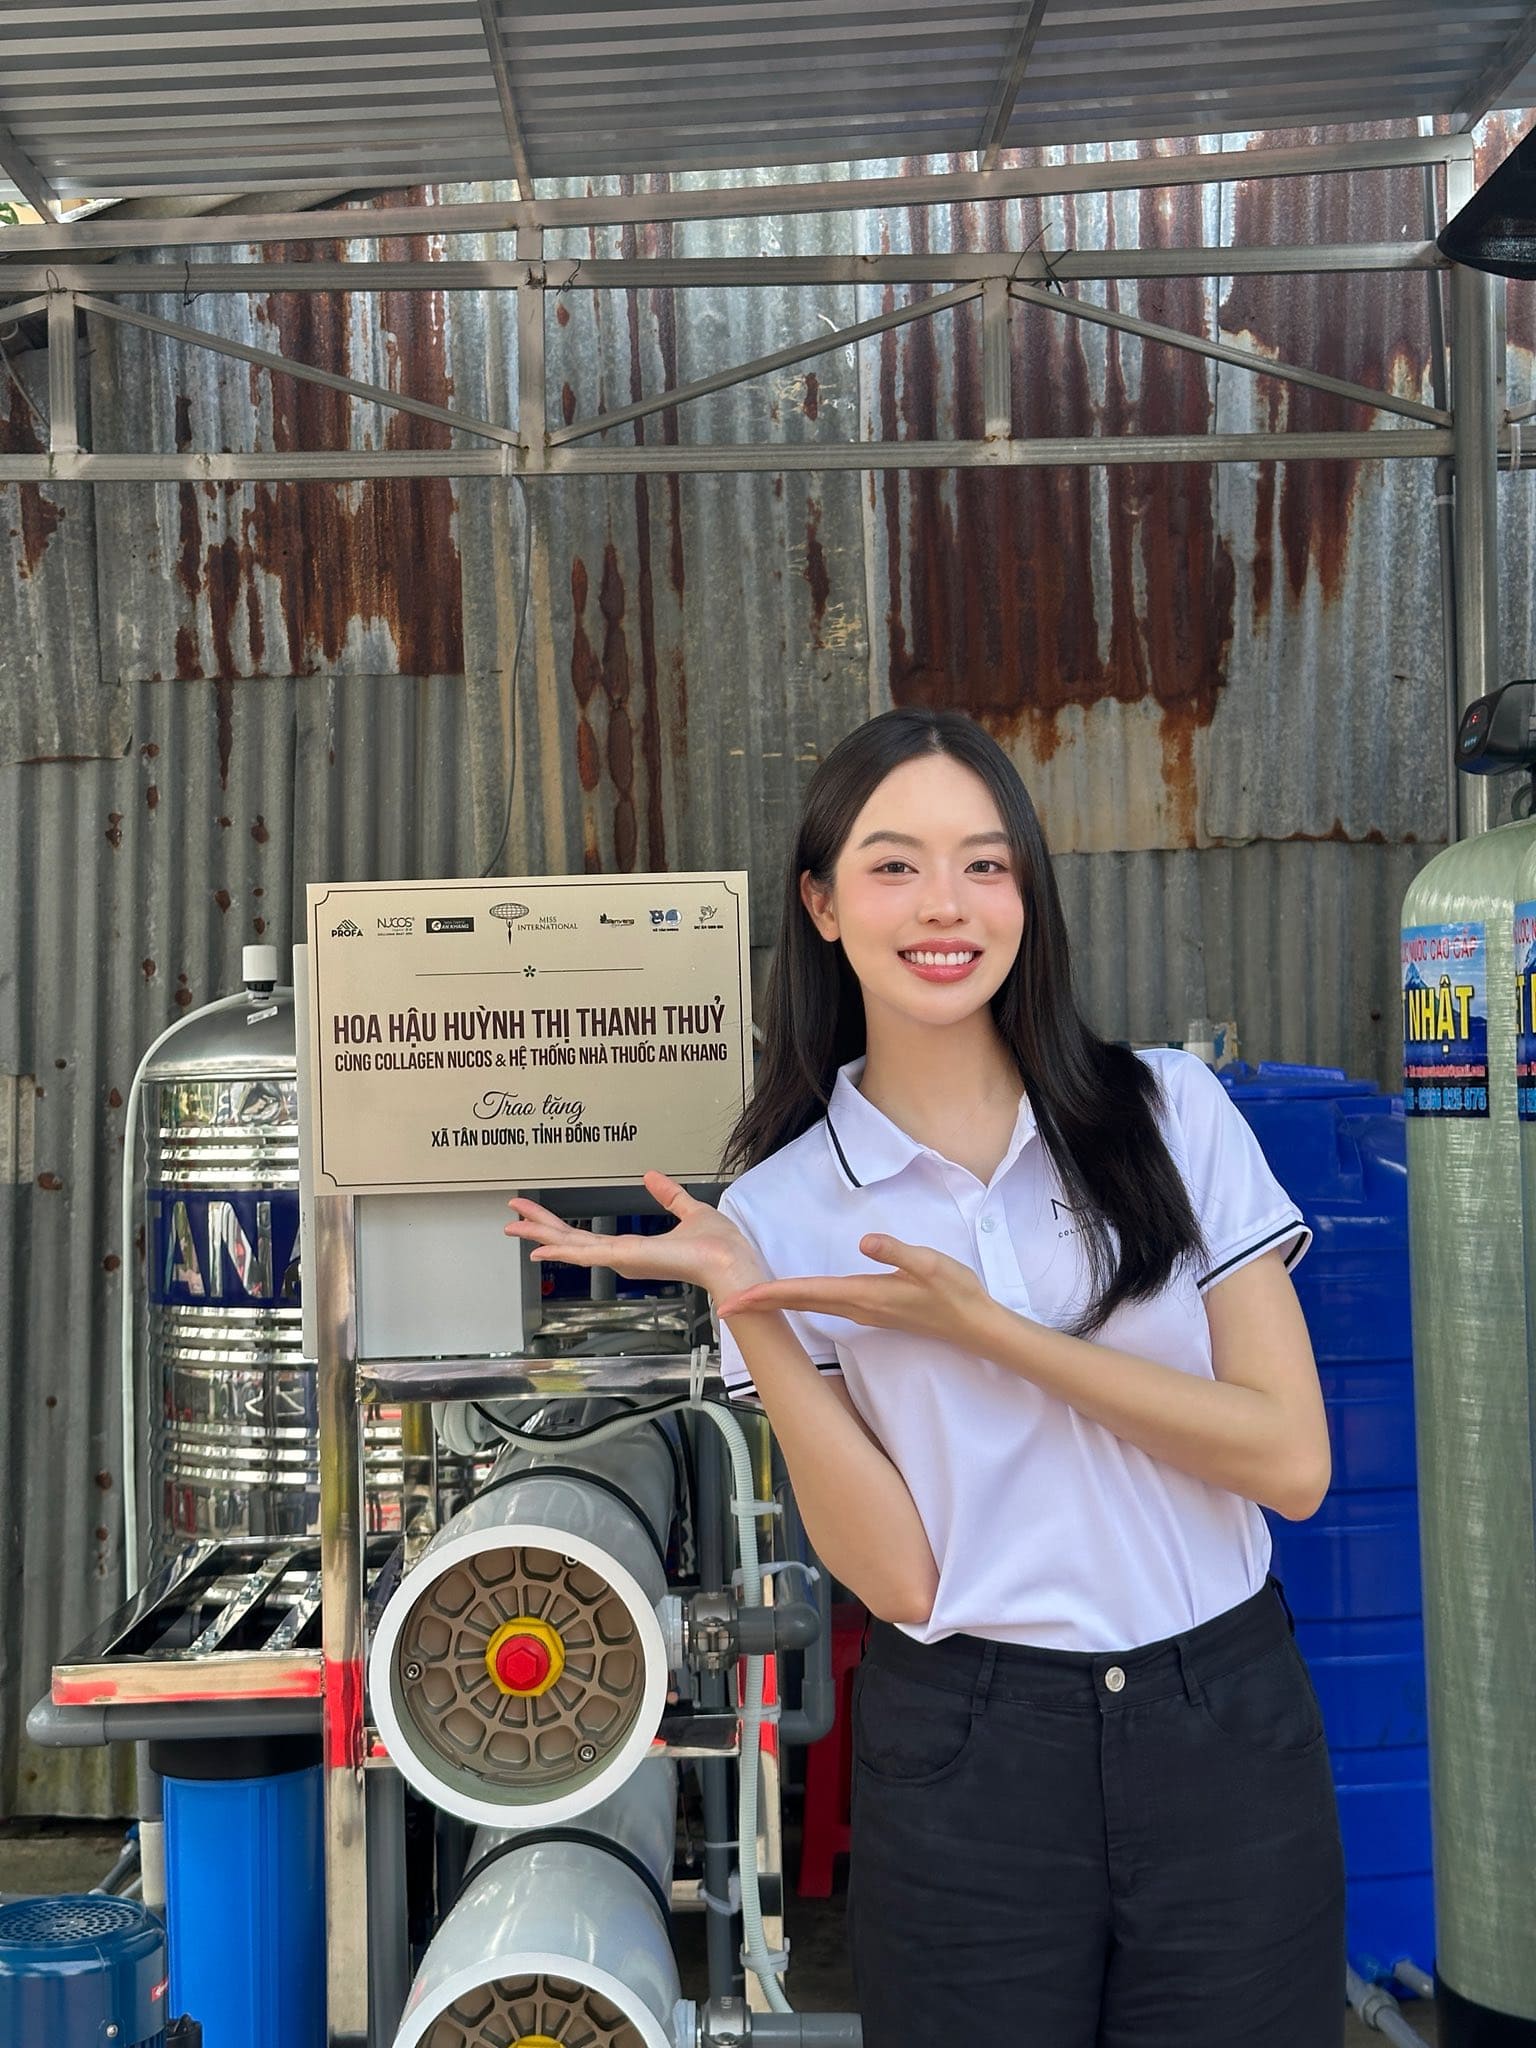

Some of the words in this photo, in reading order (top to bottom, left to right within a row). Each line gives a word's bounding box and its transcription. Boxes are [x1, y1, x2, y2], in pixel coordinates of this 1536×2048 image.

[517, 923, 579, 931] INTERNATIONAL
[538, 916, 557, 924] MISS
[331, 929, 363, 938] PROFA
[1430, 937, 1450, 960] CAO
[333, 1014, 383, 1045] HOA
[389, 1007, 437, 1049] HẬU
[443, 1005, 526, 1042] HUỲNH
[531, 1008, 570, 1044] THỊ
[576, 1006, 657, 1038] THANH
[662, 995, 725, 1035] THUỶ
[1408, 975, 1473, 1053] NHẬT
[335, 1050, 372, 1072] CÙNG
[375, 1051, 444, 1072] COLLAGEN
[447, 1050, 493, 1069] NUCOS
[495, 1053, 507, 1068] &
[509, 1045, 527, 1070] HỆ
[530, 1042, 576, 1066] THỐNG
[579, 1043, 608, 1065] NHÀ
[610, 1040, 656, 1064] THUỐC
[658, 1044, 678, 1062] AN
[680, 1043, 728, 1062] KHANG
[473, 1090, 536, 1120] Trao
[542, 1094, 586, 1125] tặng
[431, 1127, 450, 1147] XÃ
[452, 1126, 478, 1147] TÂN
[481, 1127, 529, 1147] DƯƠNG,
[532, 1123, 563, 1144] TỈNH
[565, 1121, 601, 1143] ĐỒNG
[603, 1122, 638, 1142] THÁP
